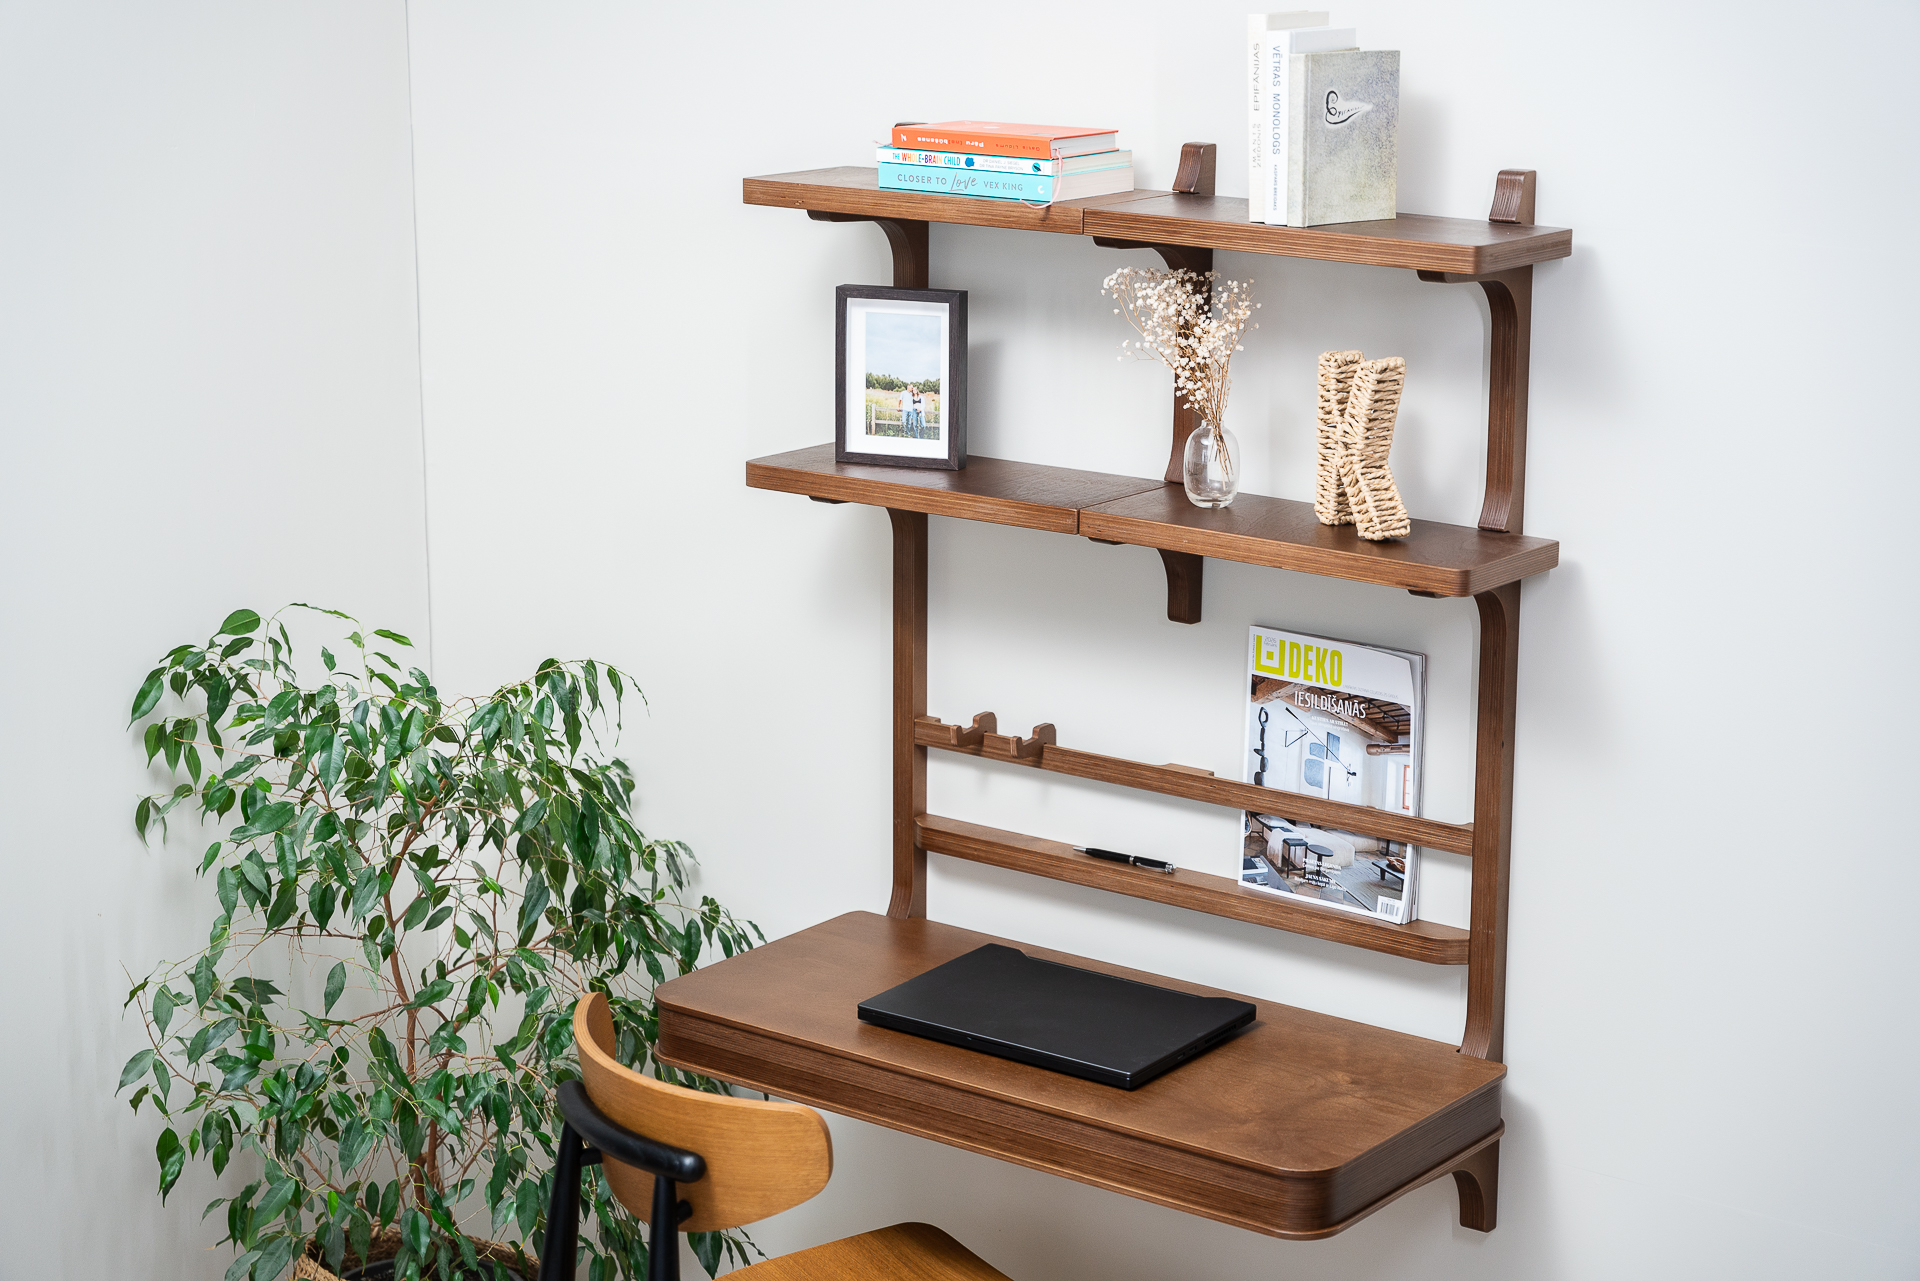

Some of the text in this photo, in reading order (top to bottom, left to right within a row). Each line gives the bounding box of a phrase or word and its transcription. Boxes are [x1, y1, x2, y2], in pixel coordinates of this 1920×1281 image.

[1272, 45, 1283, 155] VĒTRAS MONOLOGS
[892, 152, 961, 166] THE WHOLE-BRAIN CHILD
[897, 172, 1023, 192] CLOSER TO Love VEX KING
[1288, 641, 1343, 687] DEKO
[1294, 690, 1367, 719] IESILDĪŠANĀS
